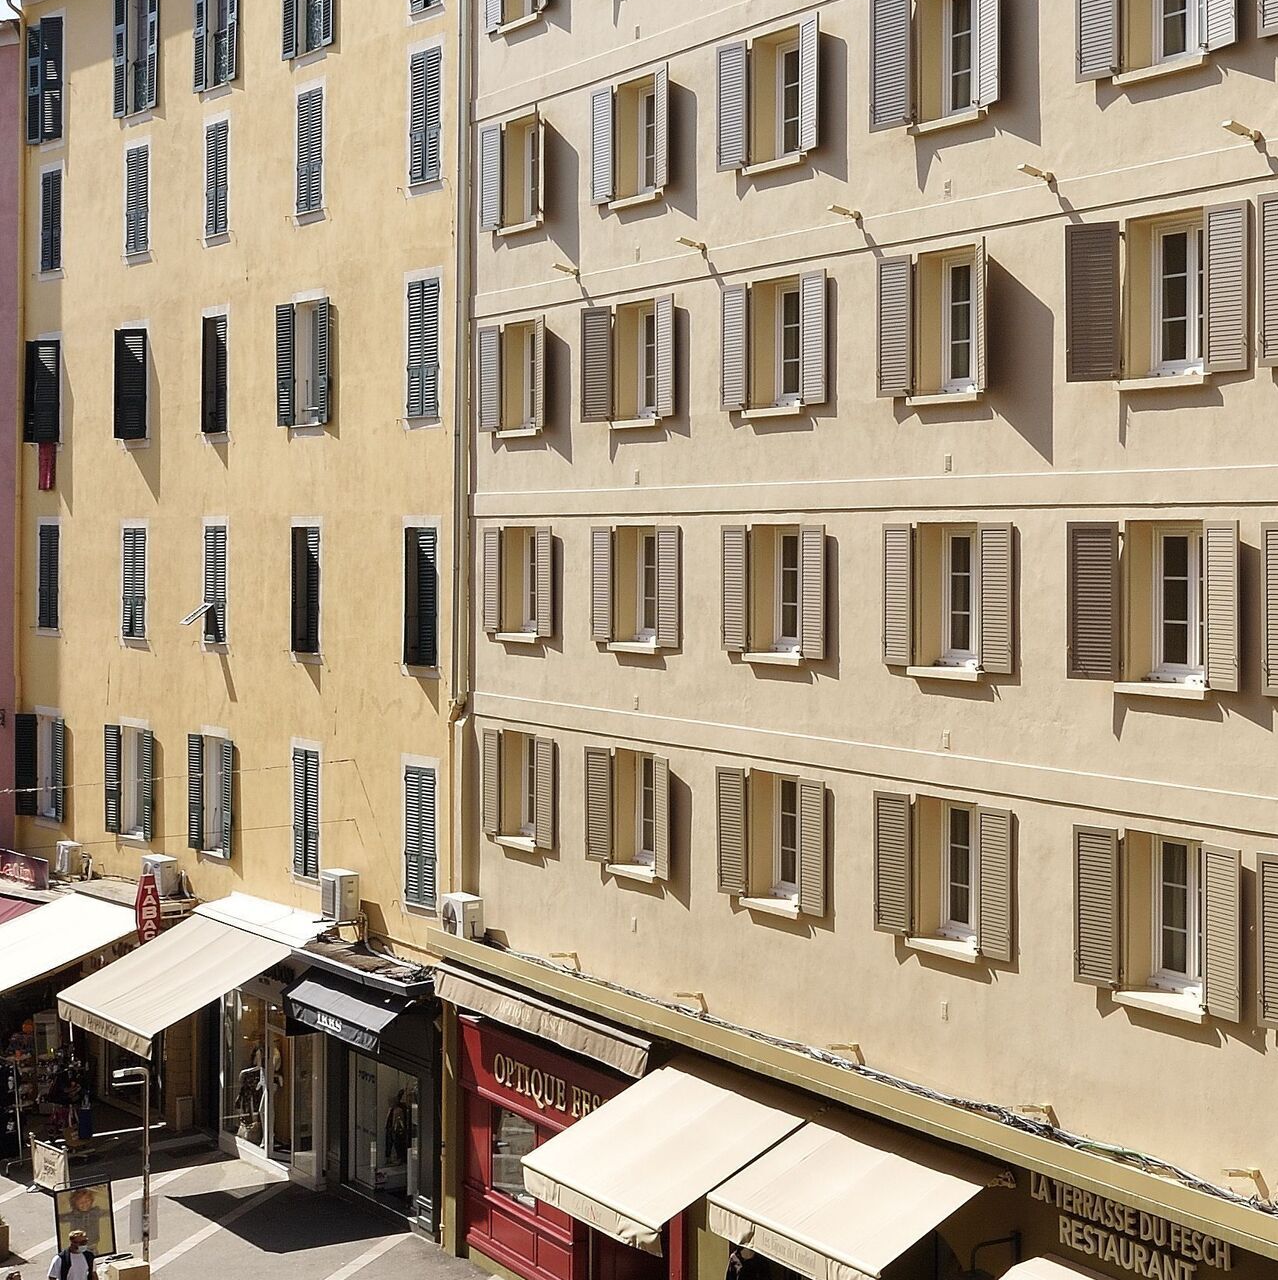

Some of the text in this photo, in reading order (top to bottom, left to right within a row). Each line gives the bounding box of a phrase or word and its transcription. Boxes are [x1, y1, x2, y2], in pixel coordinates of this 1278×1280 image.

[142, 884, 158, 942] TABAC
[316, 1011, 343, 1033] IKKS
[493, 1053, 608, 1121] OPTIQUE FES
[1030, 1171, 1232, 1271] LA TERRASSE DU FESCH
